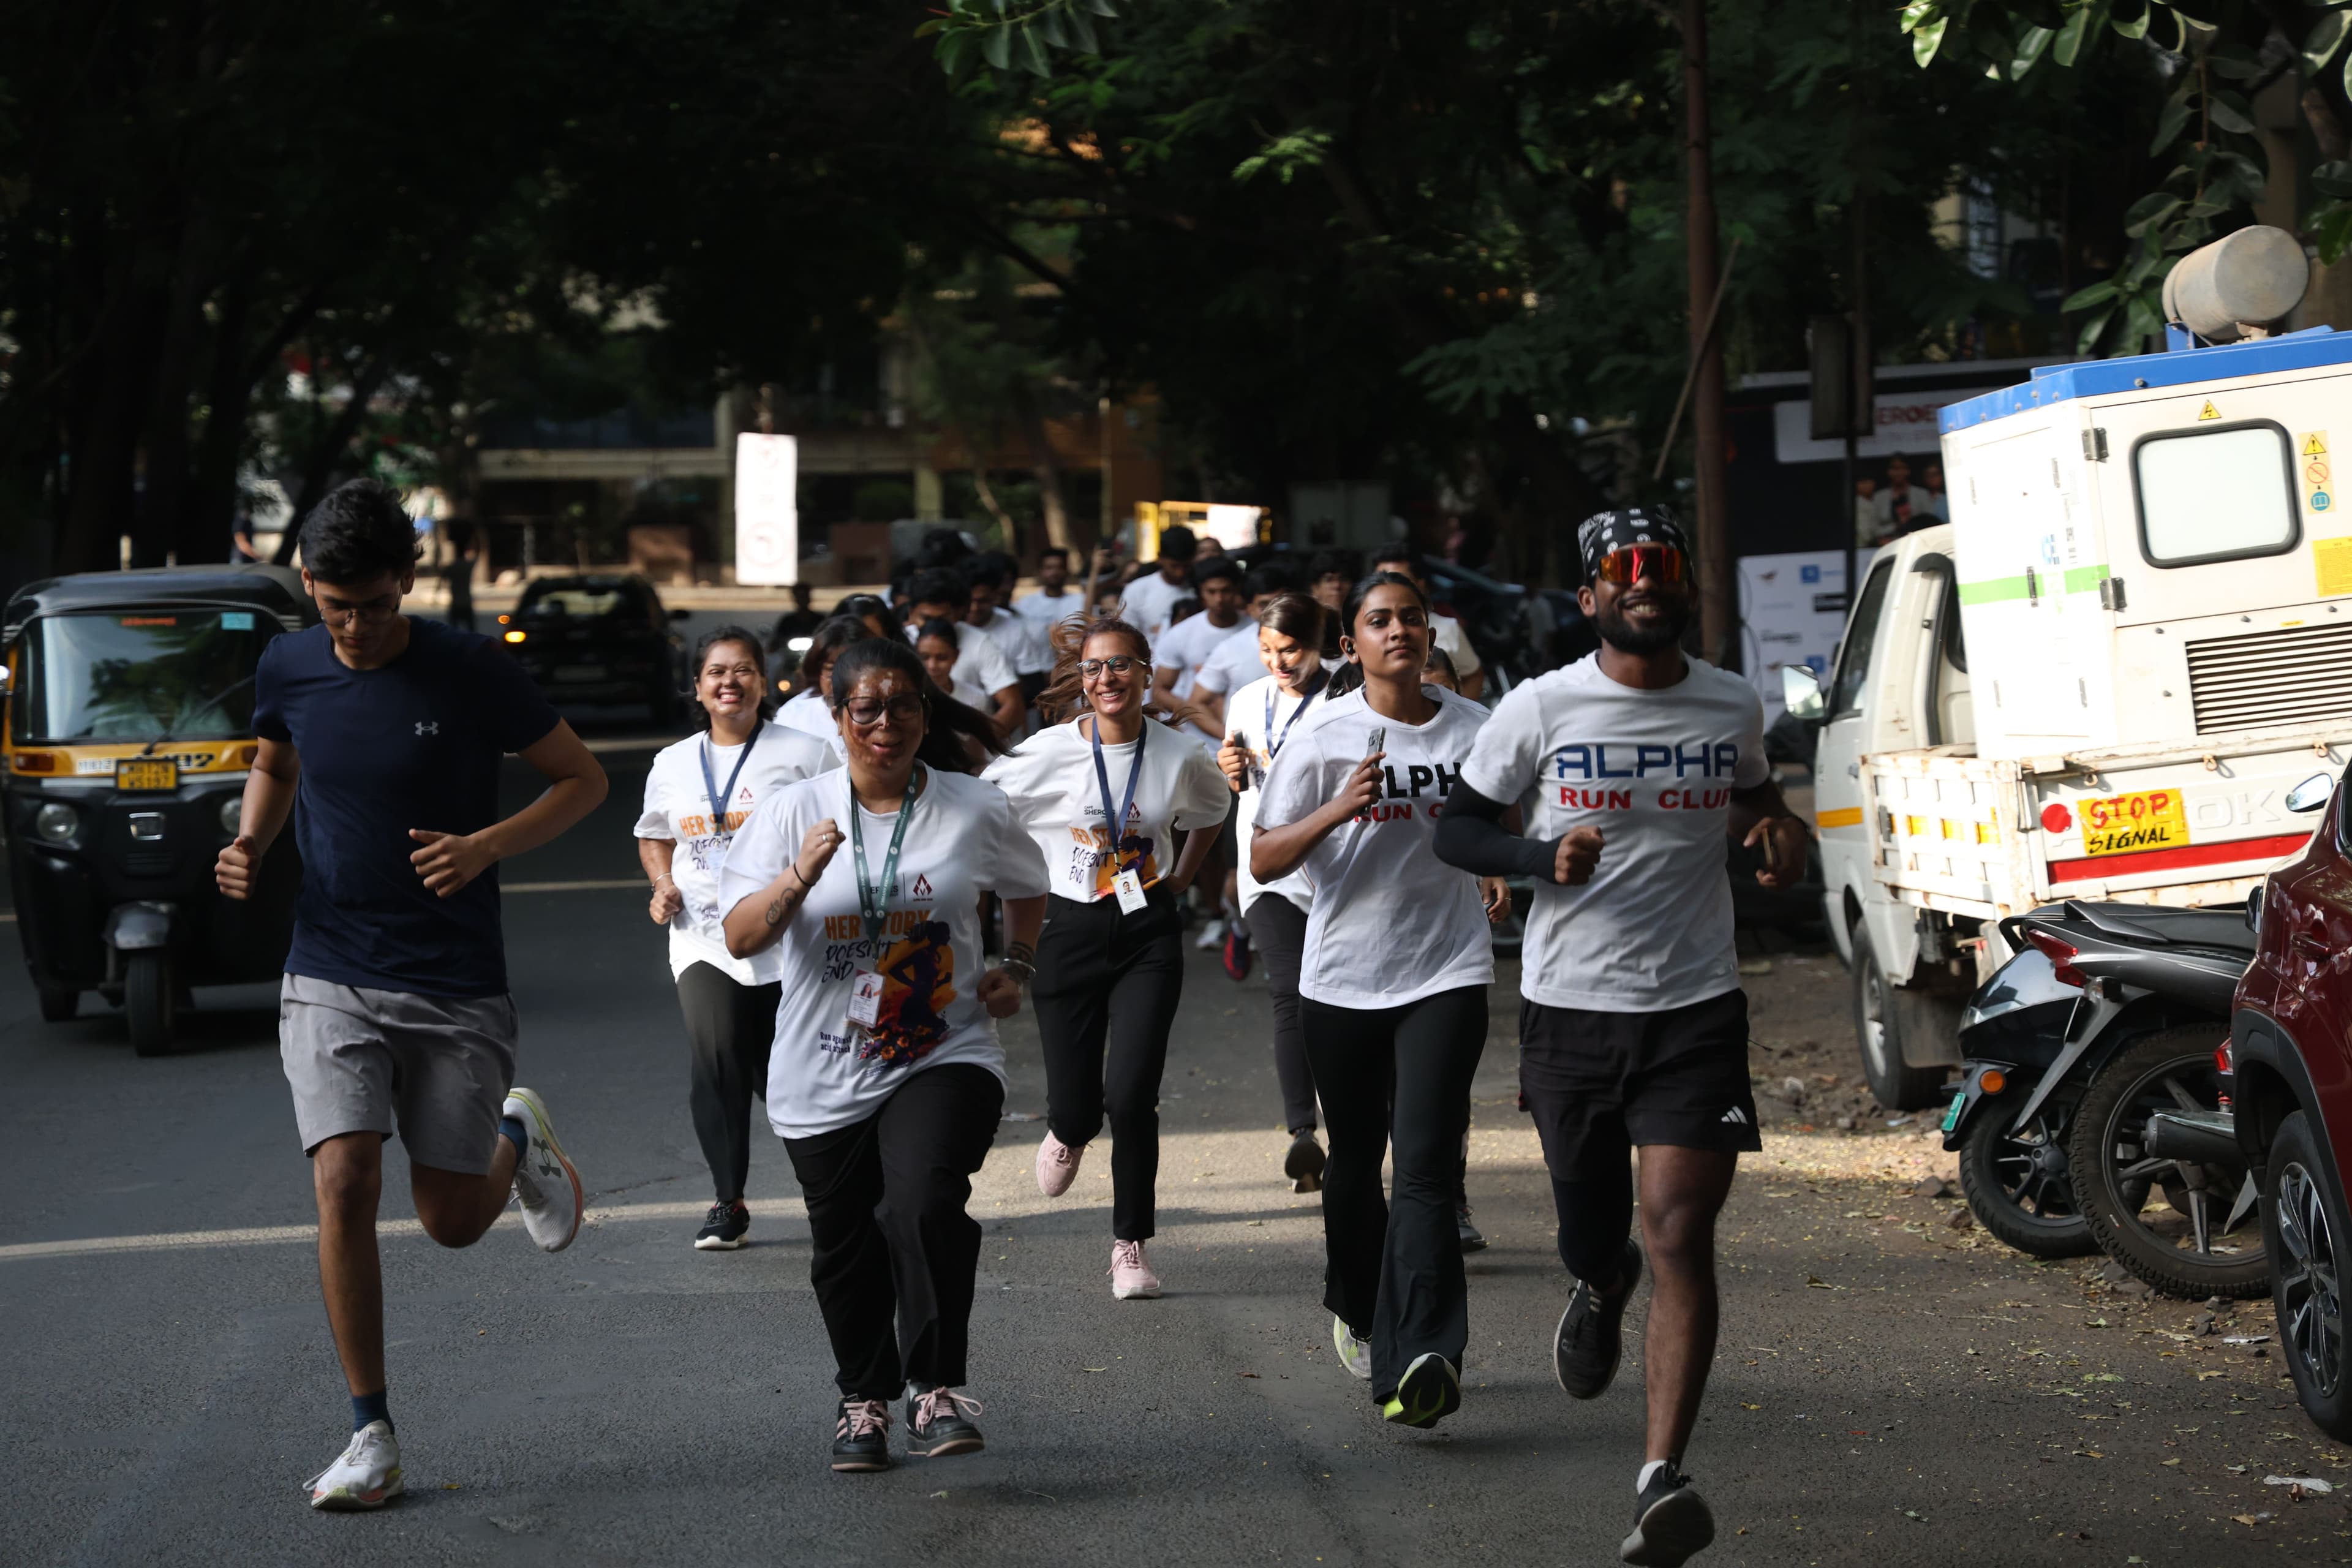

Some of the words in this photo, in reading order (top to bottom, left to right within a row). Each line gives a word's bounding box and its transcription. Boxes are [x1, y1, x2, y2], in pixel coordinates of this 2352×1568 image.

[1556, 743, 1738, 778] ALPHA
[1378, 762, 1461, 799] LPH
[1560, 786, 1632, 809] RUN
[2090, 793, 2169, 829] STOP
[679, 815, 707, 837] HER
[2089, 826, 2171, 854] SIGNAL
[1069, 866, 1085, 884] END
[824, 914, 862, 941] HER
[881, 910, 931, 937] TORY
[821, 960, 854, 983] END
[820, 1031, 831, 1041] Run
[832, 1035, 852, 1045] against
